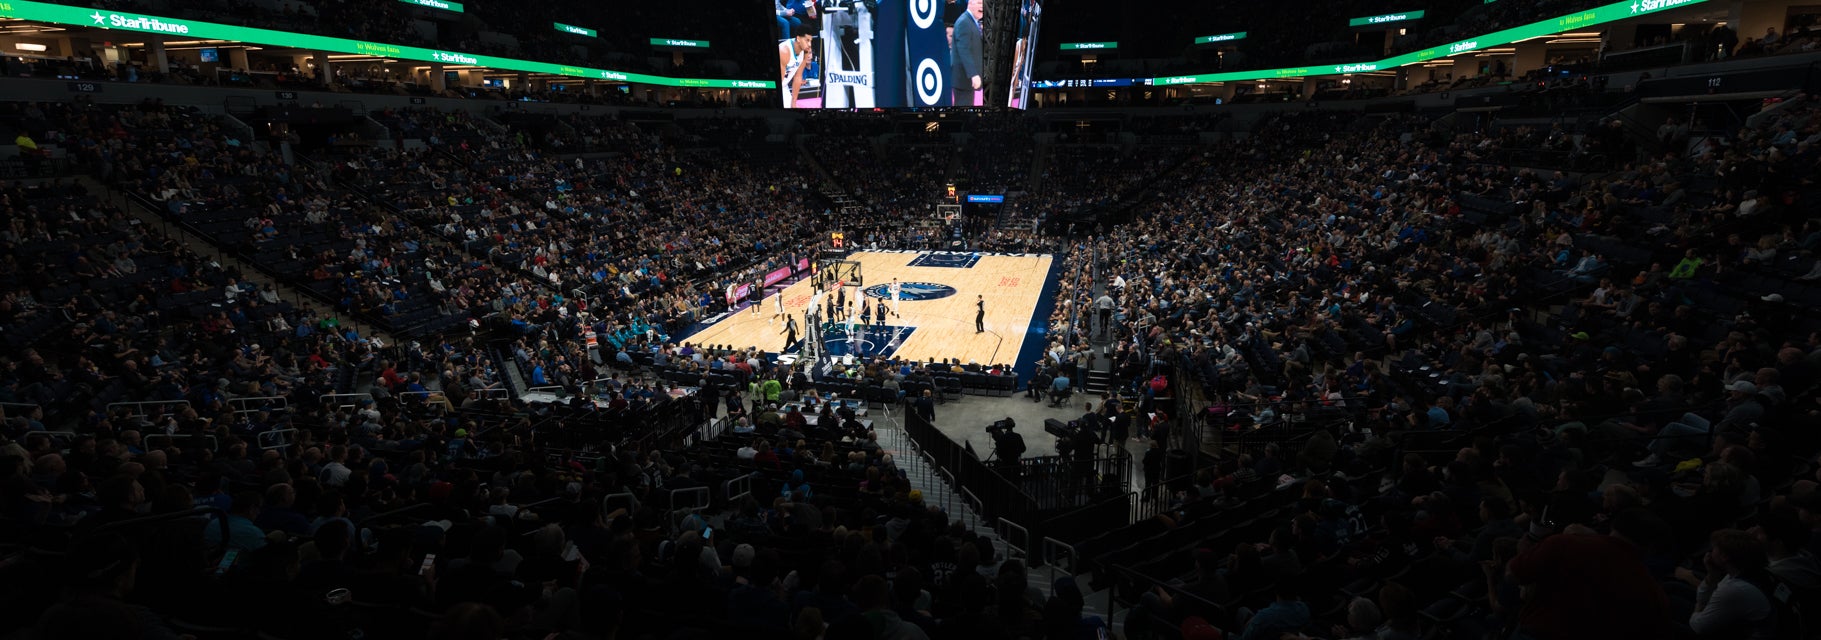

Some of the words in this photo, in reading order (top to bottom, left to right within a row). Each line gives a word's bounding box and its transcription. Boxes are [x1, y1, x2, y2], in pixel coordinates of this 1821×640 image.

[110, 14, 189, 34] StarTribune
[441, 52, 477, 64] StarTribune
[829, 73, 867, 85] SPALDING
[1708, 77, 1721, 87] 112
[77, 83, 94, 91] 129
